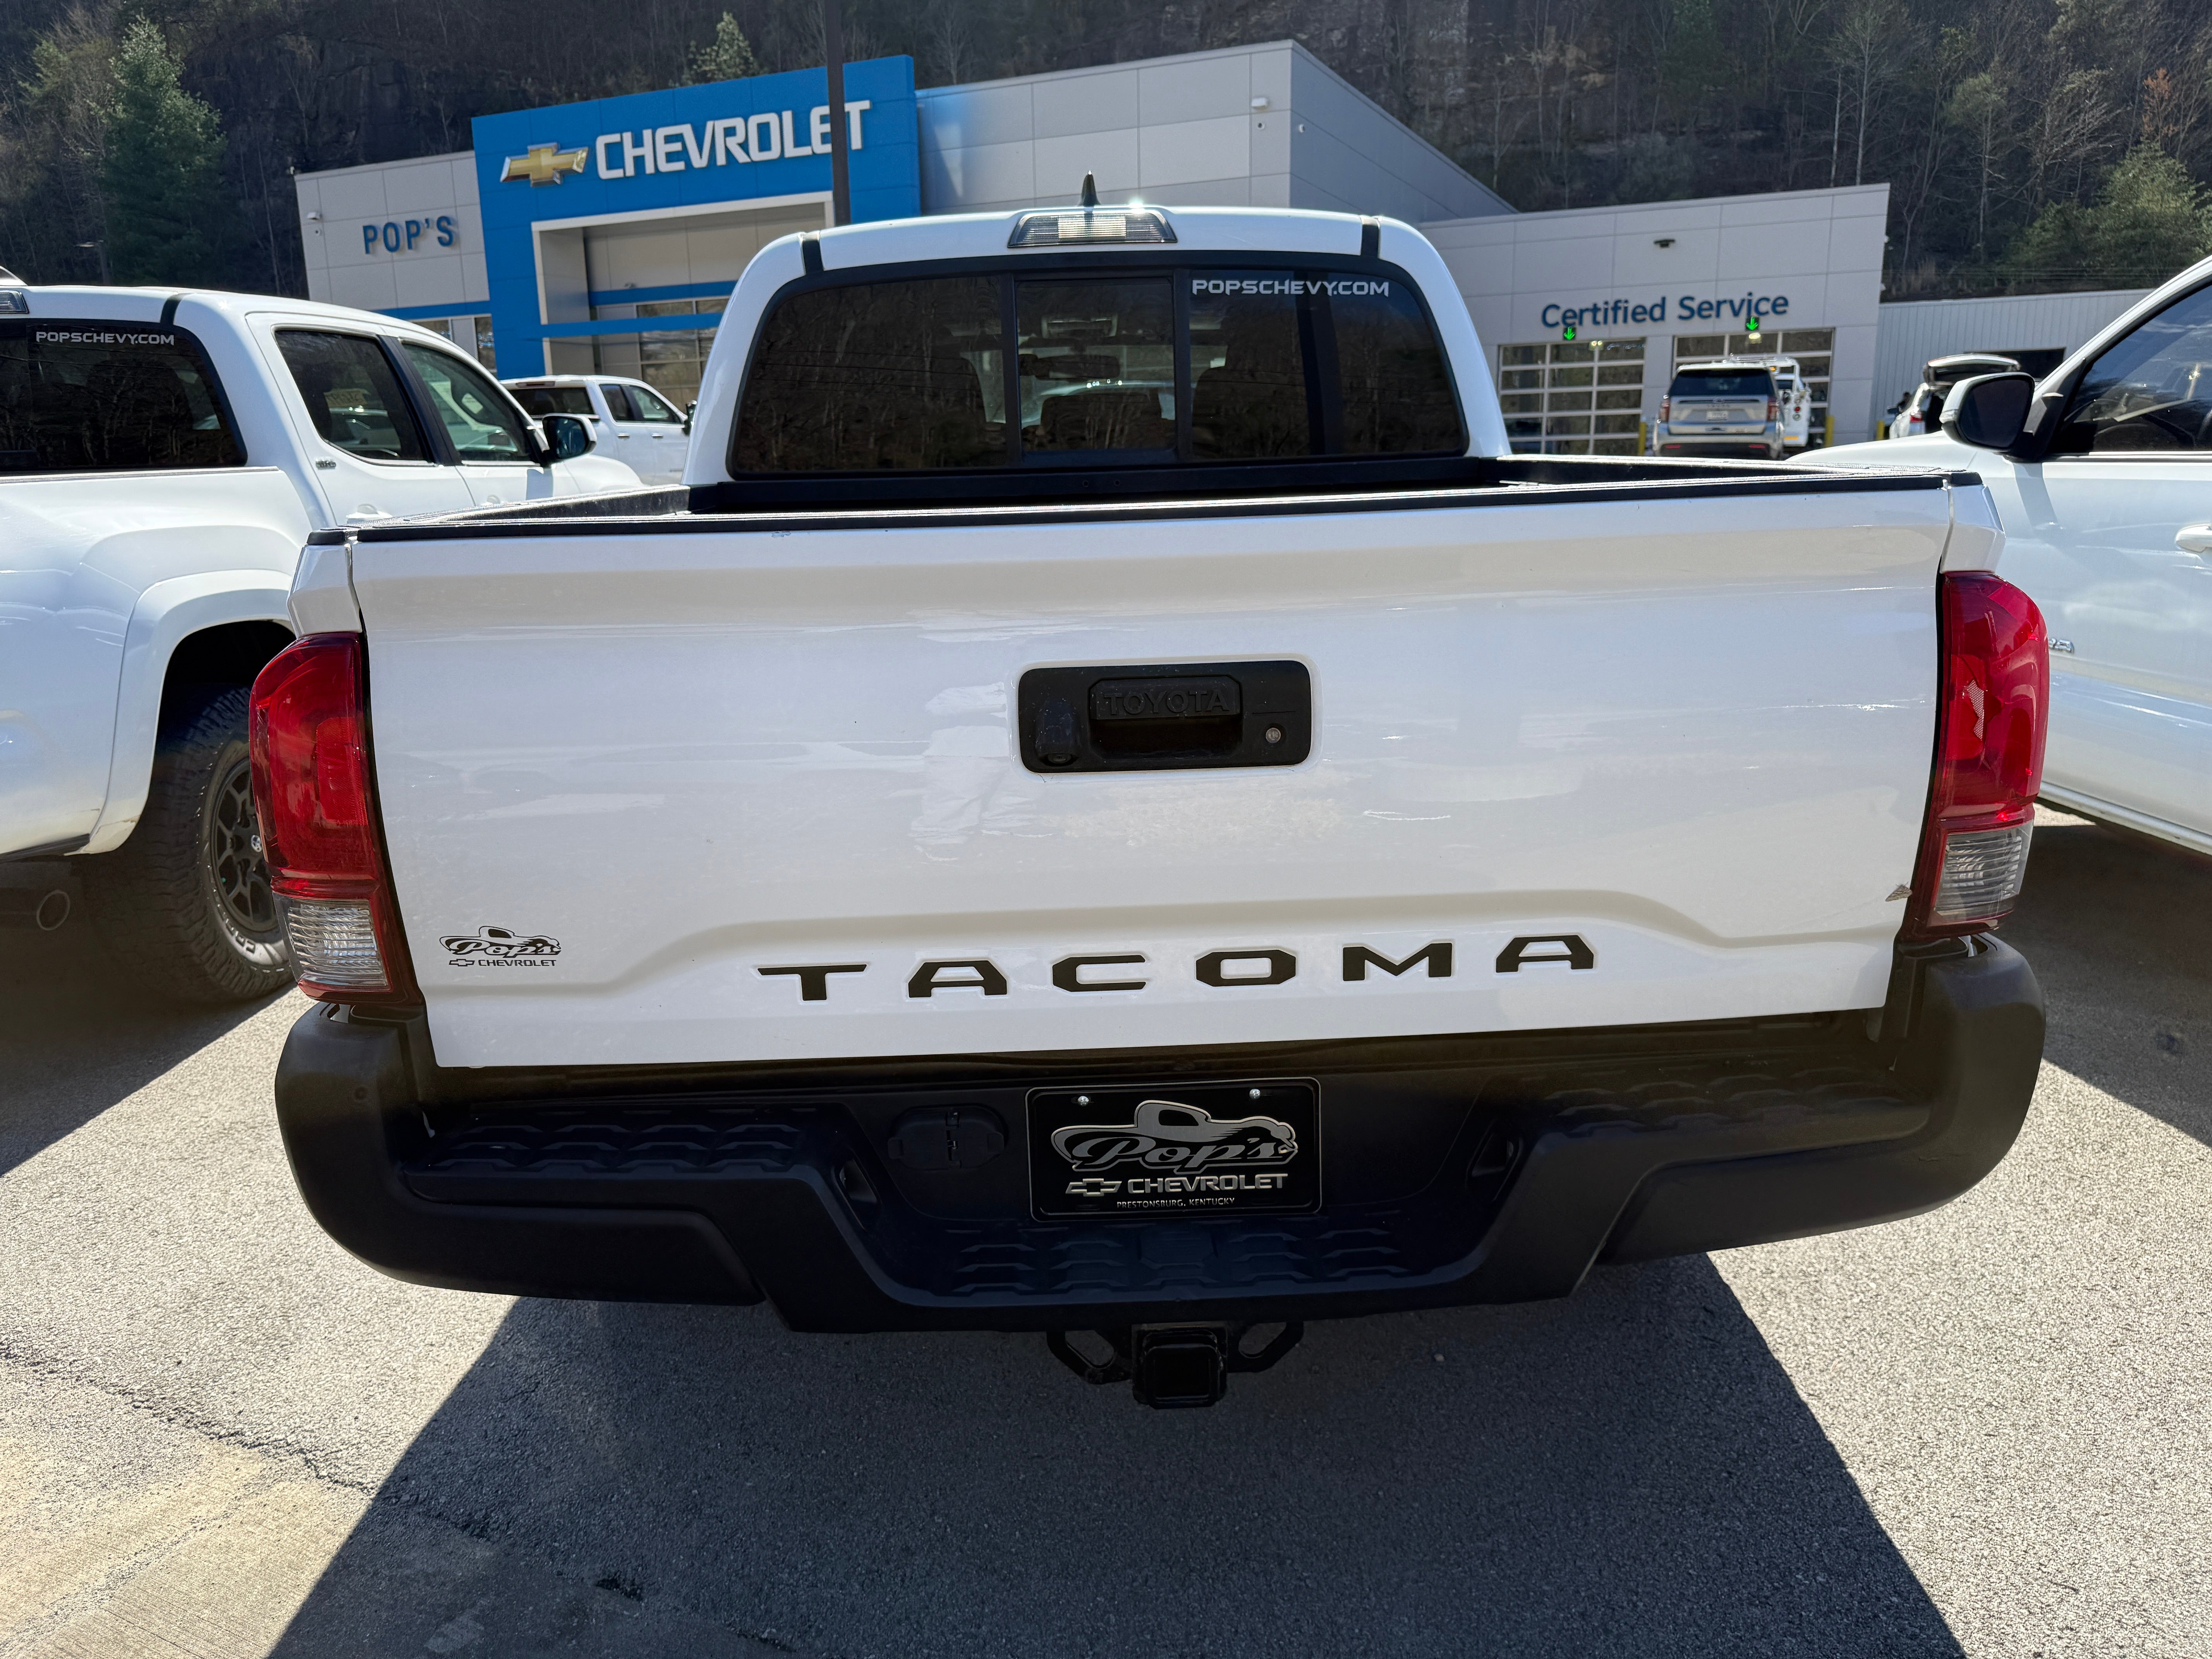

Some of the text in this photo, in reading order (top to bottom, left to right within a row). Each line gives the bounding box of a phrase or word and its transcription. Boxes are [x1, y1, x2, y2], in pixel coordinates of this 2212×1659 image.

[596, 100, 871, 180] CHEVROLET
[363, 216, 454, 254] POP'S
[1192, 279, 1389, 297] POPSCHEVY.COM
[1541, 292, 1789, 328] Certified Service
[36, 331, 175, 346] POPSCHEVY.COM
[1104, 689, 1230, 715] TOYOTA
[757, 933, 1598, 1003] TACOMA
[1072, 1136, 1284, 1170] Pop's
[1128, 1173, 1288, 1194] CHEVROLET
[1189, 1197, 1235, 1206] KENTUCKY
